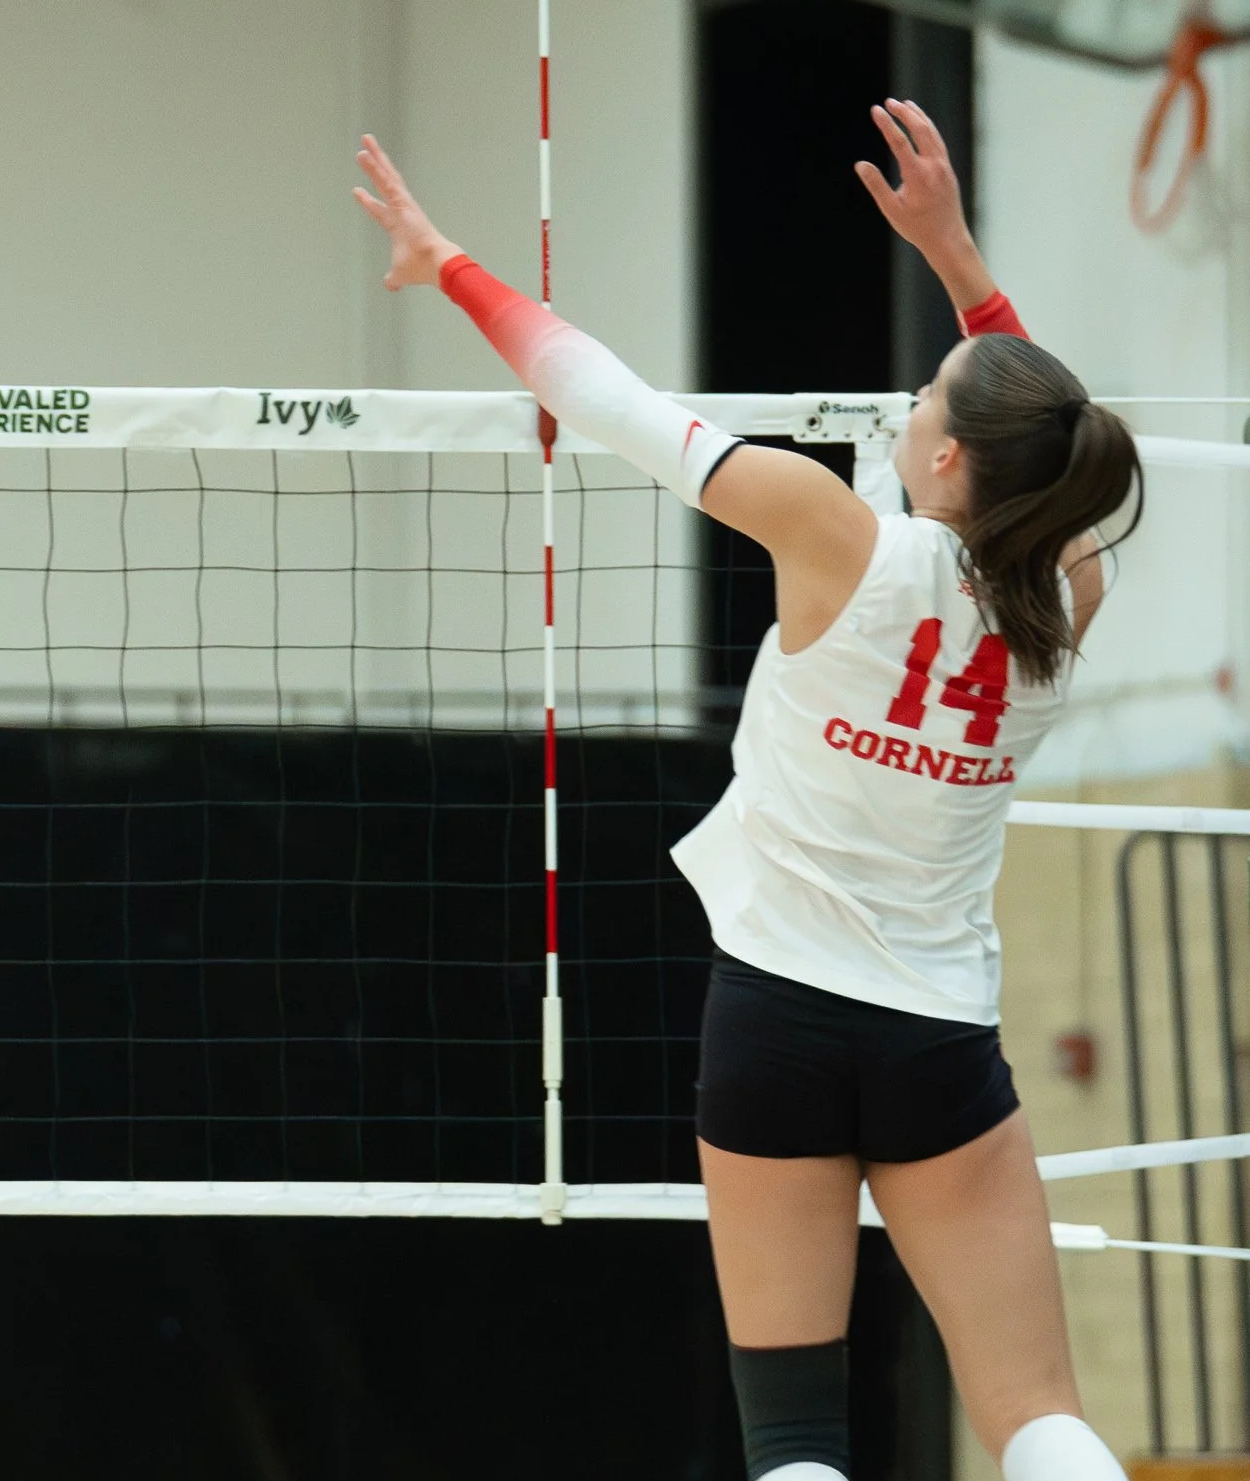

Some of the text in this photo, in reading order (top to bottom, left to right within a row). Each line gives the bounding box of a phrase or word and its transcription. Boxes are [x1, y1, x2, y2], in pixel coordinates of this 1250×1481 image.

[257, 392, 322, 436] Ivy
[886, 617, 1011, 748] 14
[823, 717, 1017, 787] CORNELL
